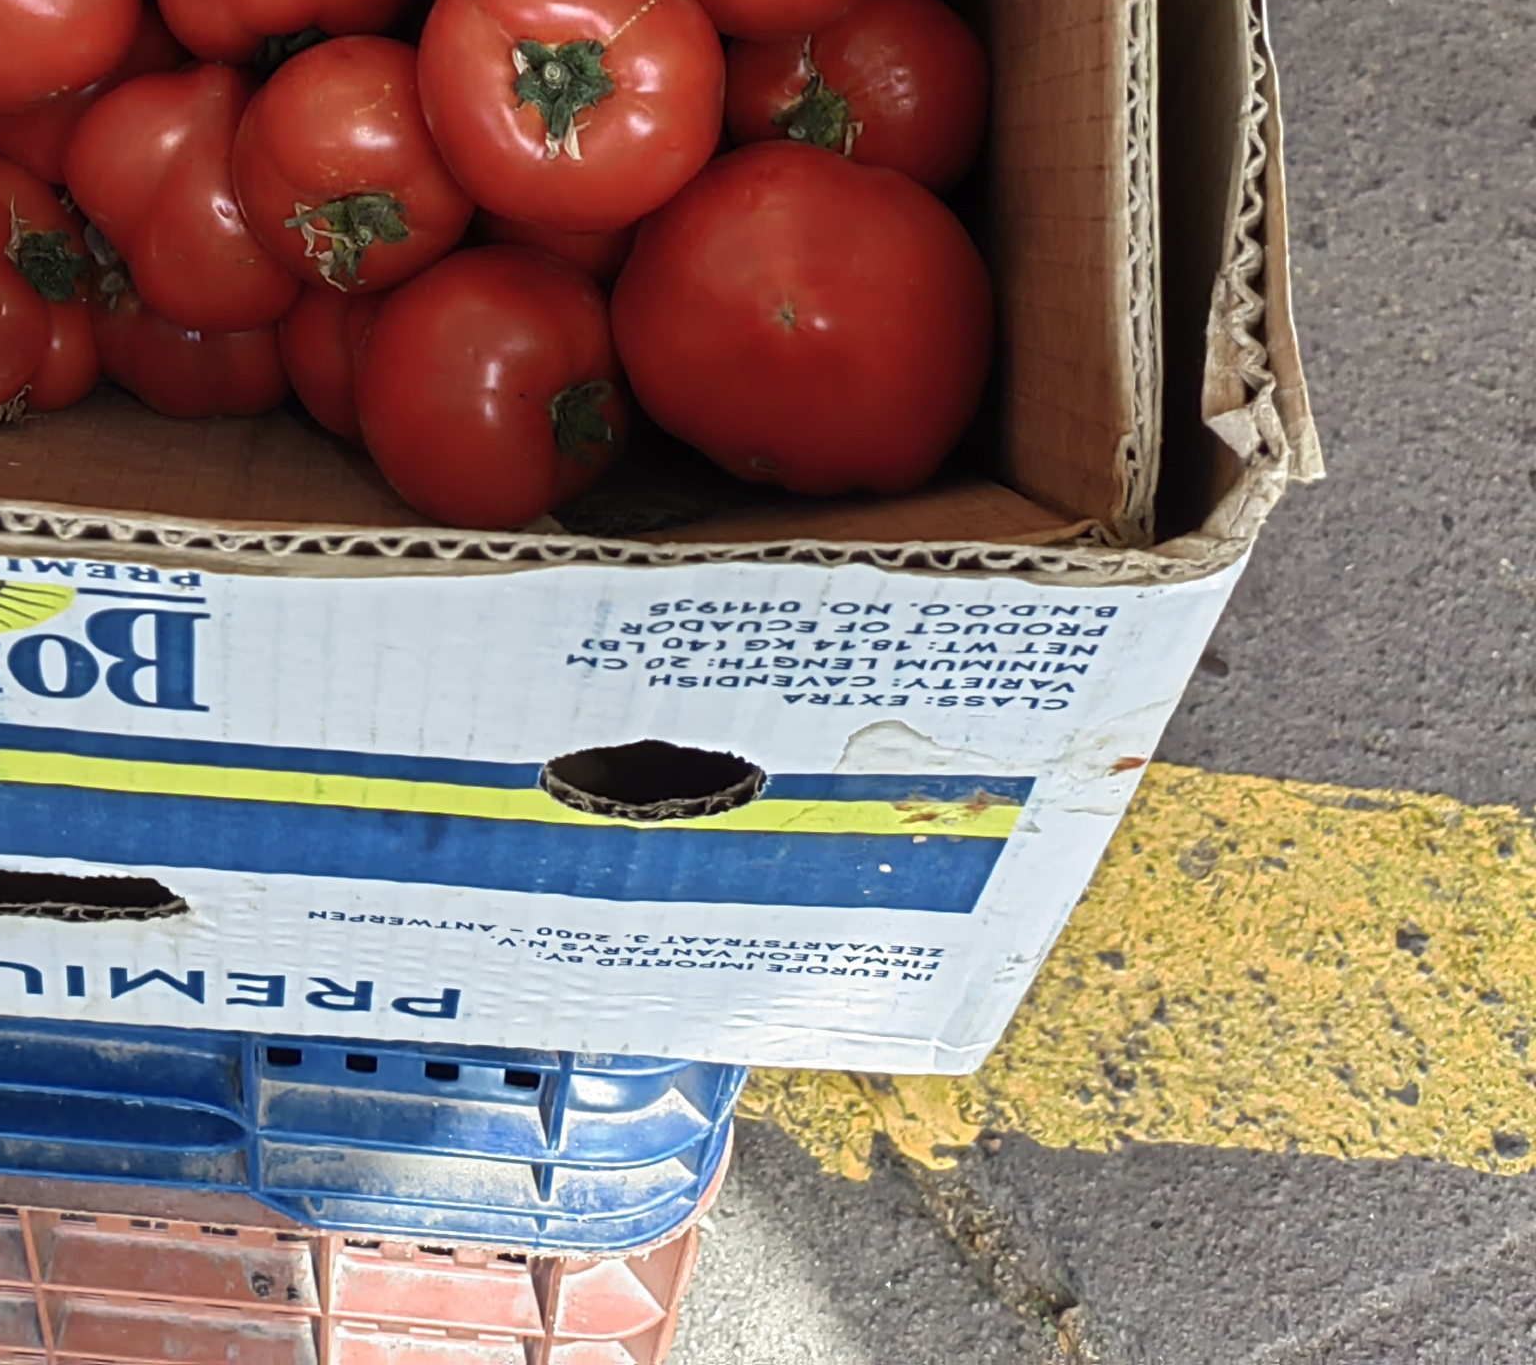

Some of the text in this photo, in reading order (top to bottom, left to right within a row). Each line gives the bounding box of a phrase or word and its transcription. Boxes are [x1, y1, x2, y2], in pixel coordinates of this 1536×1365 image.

[648, 599, 802, 617] 0111935
[821, 602, 893, 616] NO.
[619, 619, 1110, 637] PRODUCT OF ECUADOR
[581, 638, 646, 654] LB)
[661, 637, 727, 652] (40
[744, 637, 796, 652] KG
[927, 641, 999, 654] WT:
[1014, 641, 1100, 657] NET
[565, 653, 1090, 675] MINIMUM LENGTH: 20 CM
[648, 673, 1076, 693] VARIETY: CAVENDISH
[782, 693, 1069, 710] CLASS: EXTRA
[307, 910, 498, 933] ANTWERPEN
[536, 926, 612, 943] 2000
[560, 942, 661, 957] PARYS
[660, 934, 945, 958] ZEEVAARTSTRAAT
[672, 947, 733, 959] VAN
[745, 950, 829, 963] LEON
[842, 954, 940, 970] FIRMA
[534, 951, 934, 982] IN EUROPE IMPORTED BY:
